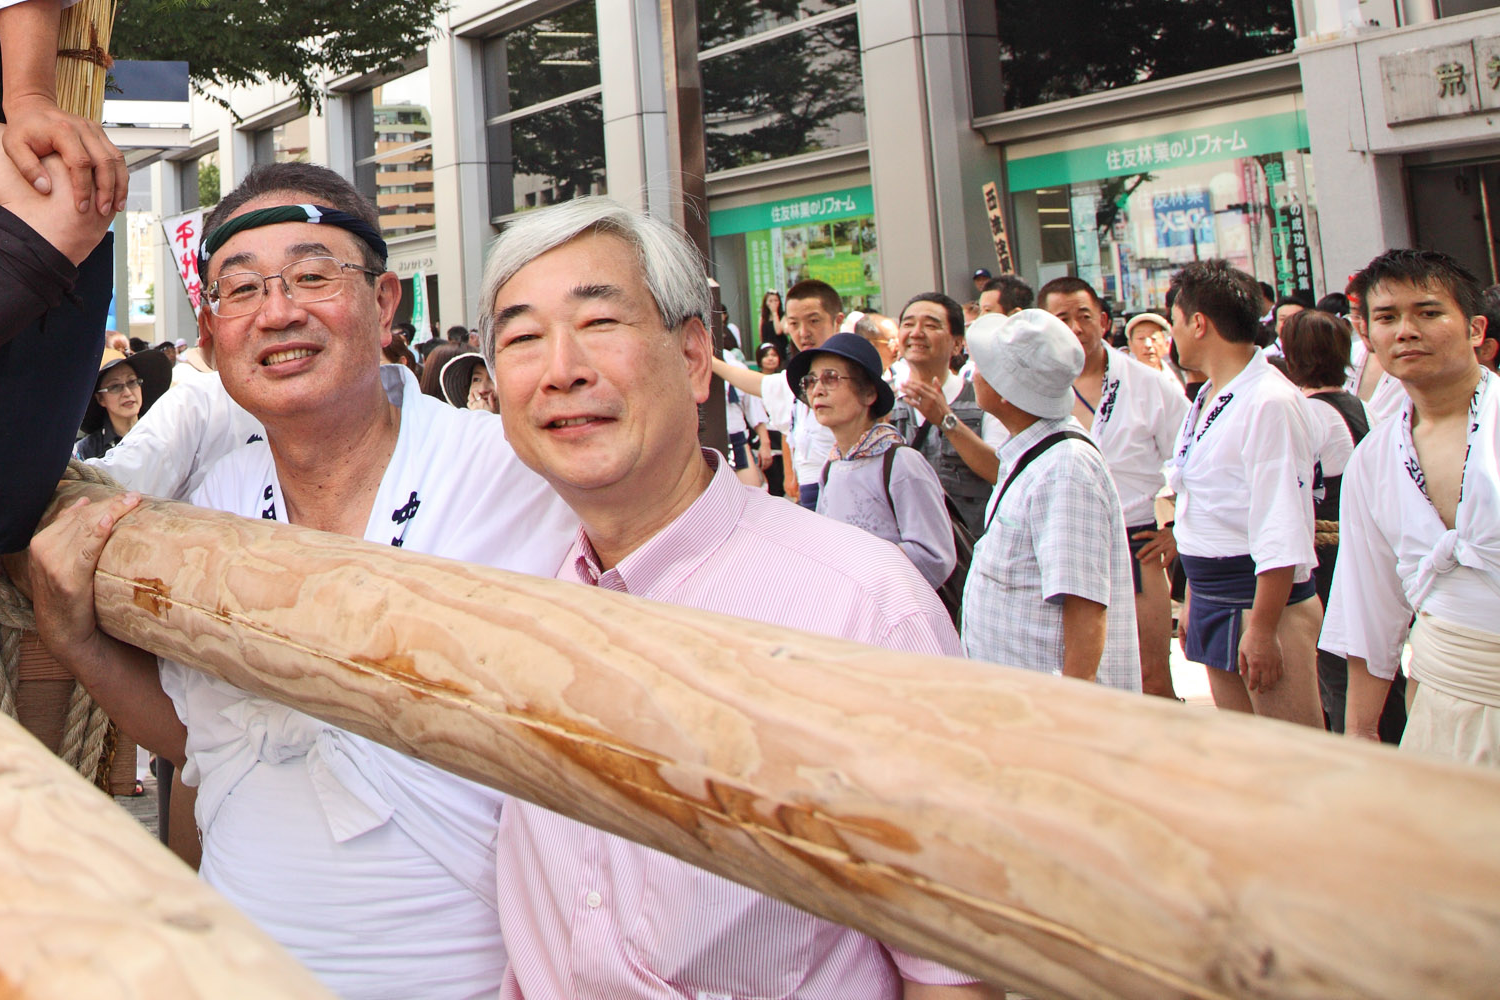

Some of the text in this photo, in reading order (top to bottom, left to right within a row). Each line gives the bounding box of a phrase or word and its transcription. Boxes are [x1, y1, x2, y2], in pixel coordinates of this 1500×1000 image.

[1106, 129, 1248, 171] 住友林業のリフォーム
[771, 194, 856, 223] 住友林業のリフォーム
